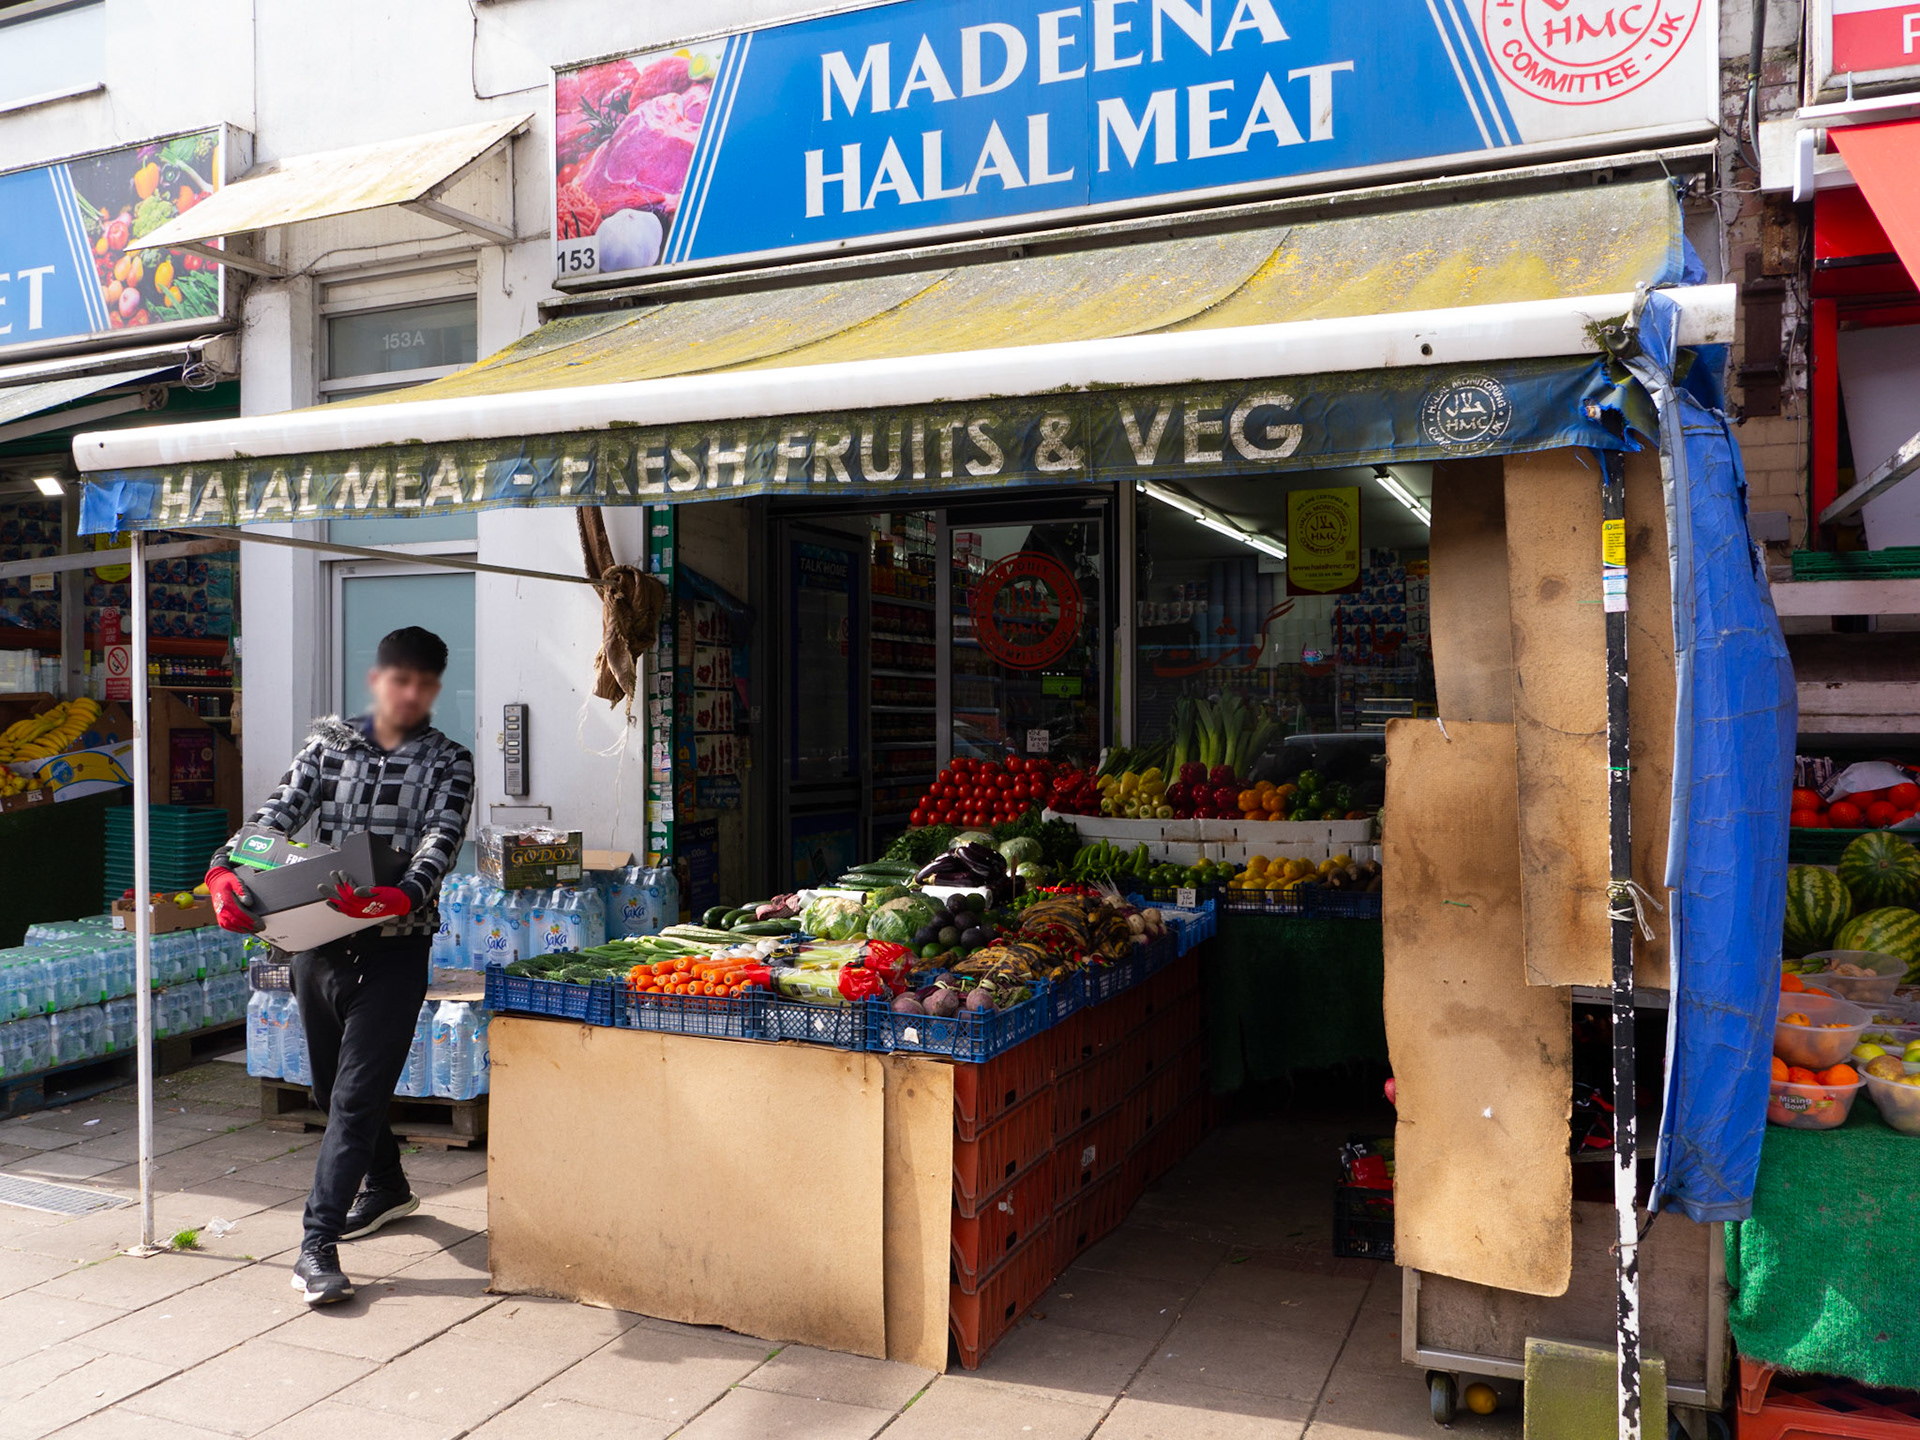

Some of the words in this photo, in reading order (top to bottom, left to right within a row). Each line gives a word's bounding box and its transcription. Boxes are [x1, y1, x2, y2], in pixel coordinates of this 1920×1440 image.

[1543, 4, 1642, 48] HMC
[820, 0, 1291, 121] MADEENA
[1502, 39, 1641, 93] COMMITTEE
[1650, 12, 1685, 47] UK
[804, 113, 1075, 218] HALAL
[1097, 60, 1354, 173] MEAT
[557, 248, 595, 272] 153
[382, 330, 426, 350] 153A
[1452, 378, 1506, 408] MONITORING
[1446, 416, 1487, 432] HMC
[159, 465, 318, 523] HALAL
[335, 456, 496, 509] MEAT
[559, 432, 748, 496] FRESH
[774, 416, 1004, 483] FRUITS
[1034, 409, 1086, 472] &
[1118, 392, 1303, 465] VEG
[1311, 532, 1337, 541] HMC
[248, 838, 268, 851] argo
[285, 853, 308, 865] FRE
[511, 847, 578, 868] GODOY
[1779, 1096, 1812, 1106] Mixing
[1784, 1102, 1806, 1110] Bowl
